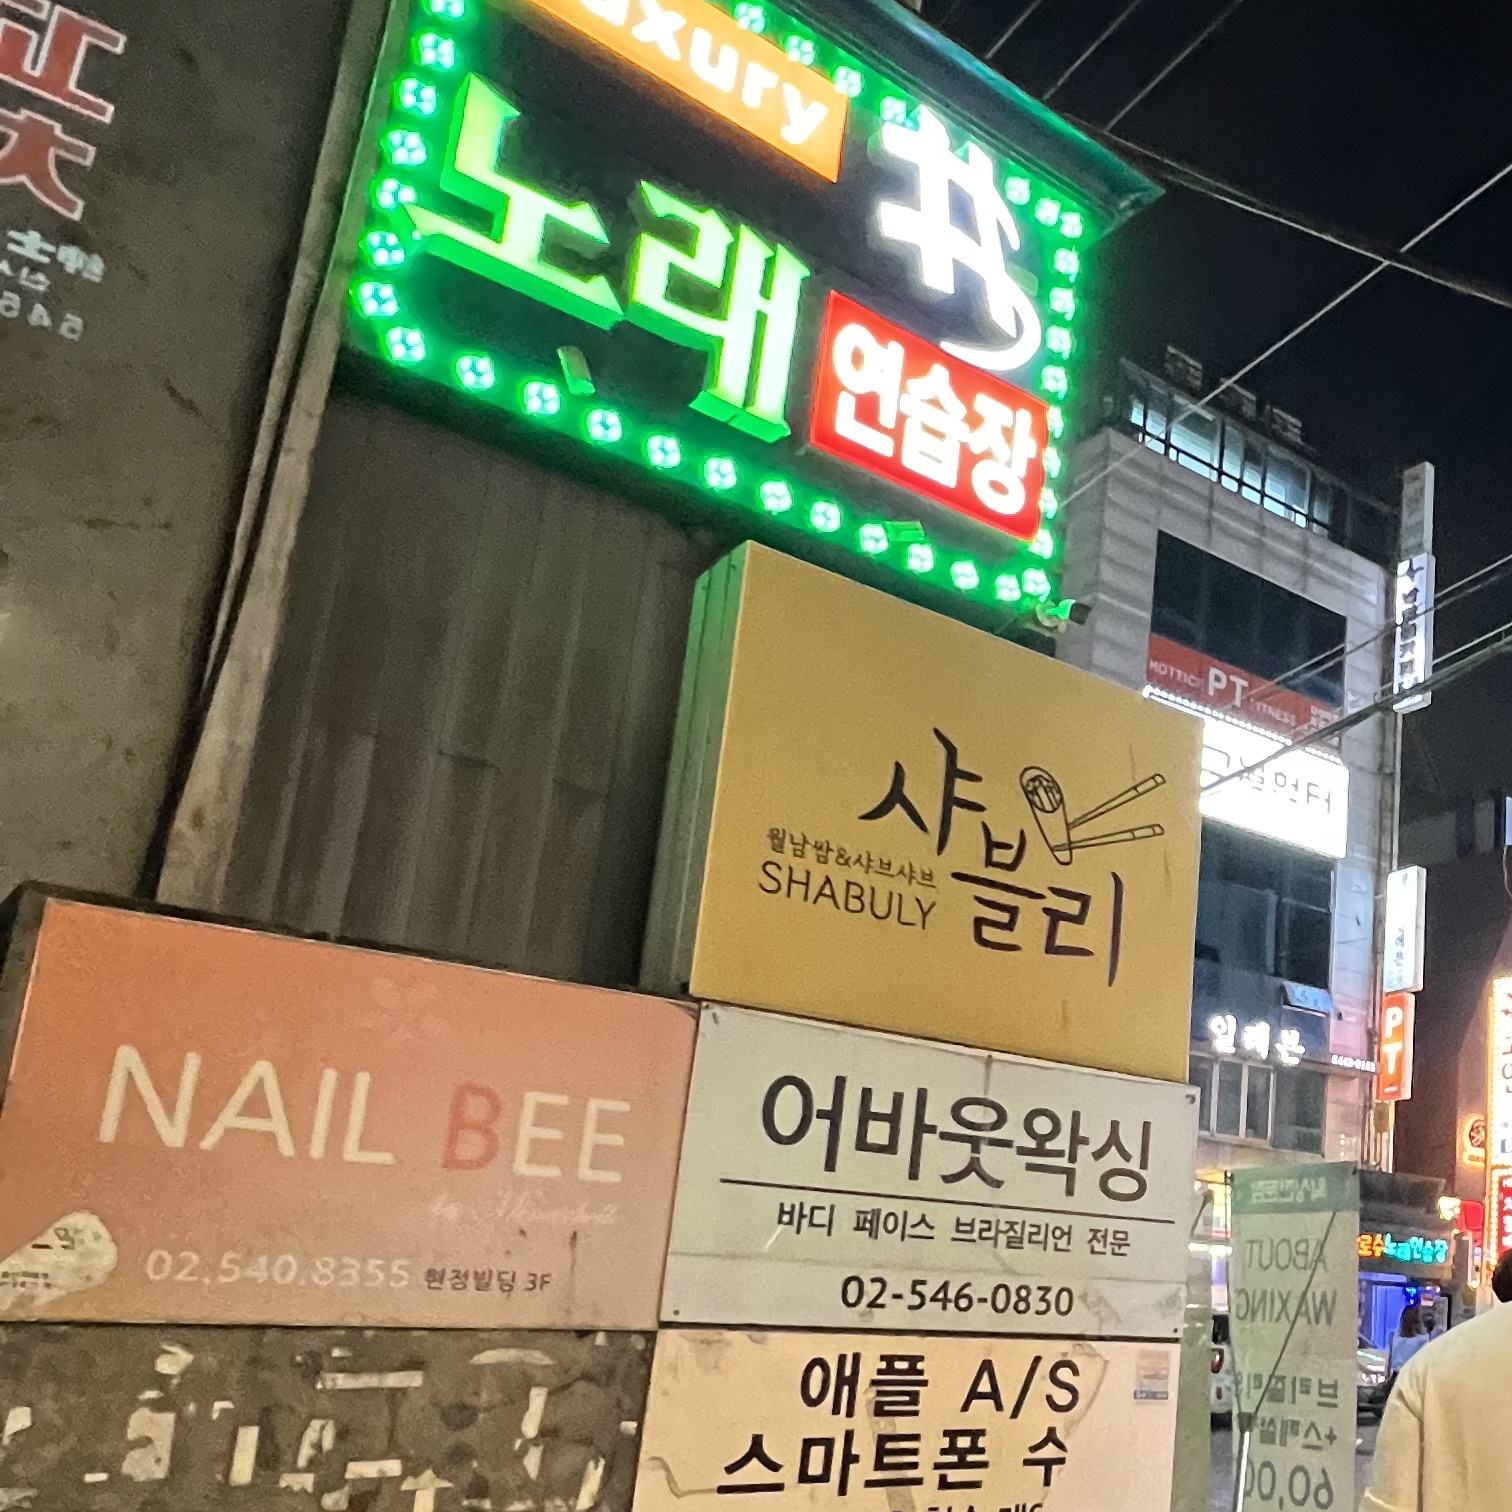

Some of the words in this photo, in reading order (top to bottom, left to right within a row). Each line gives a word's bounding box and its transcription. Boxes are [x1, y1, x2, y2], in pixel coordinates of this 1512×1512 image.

[403, 74, 809, 430] 노래
[832, 324, 1036, 515] 연습장
[1208, 666, 1249, 708] PT
[859, 725, 1124, 987] 샤블리
[758, 860, 937, 931] SHABULY
[1383, 1006, 1404, 1075] PT
[98, 1044, 397, 1165] NAIL
[441, 1083, 632, 1184] BEE
[761, 1075, 1152, 1202] 어바웃왁싱
[777, 1201, 834, 1236] 바디
[853, 1206, 936, 1244] 페이스
[951, 1216, 1073, 1255] 브라질리언
[1087, 1226, 1132, 1258] 전문
[147, 1249, 411, 1289] 02.540.8355
[525, 1272, 552, 1292] 3F
[841, 1276, 1075, 1316] 02-546-0830
[800, 1351, 930, 1419] 애플
[961, 1355, 1080, 1420] A/S
[716, 1427, 990, 1497] 스마트폰
[1022, 1425, 1068, 1488] 수
